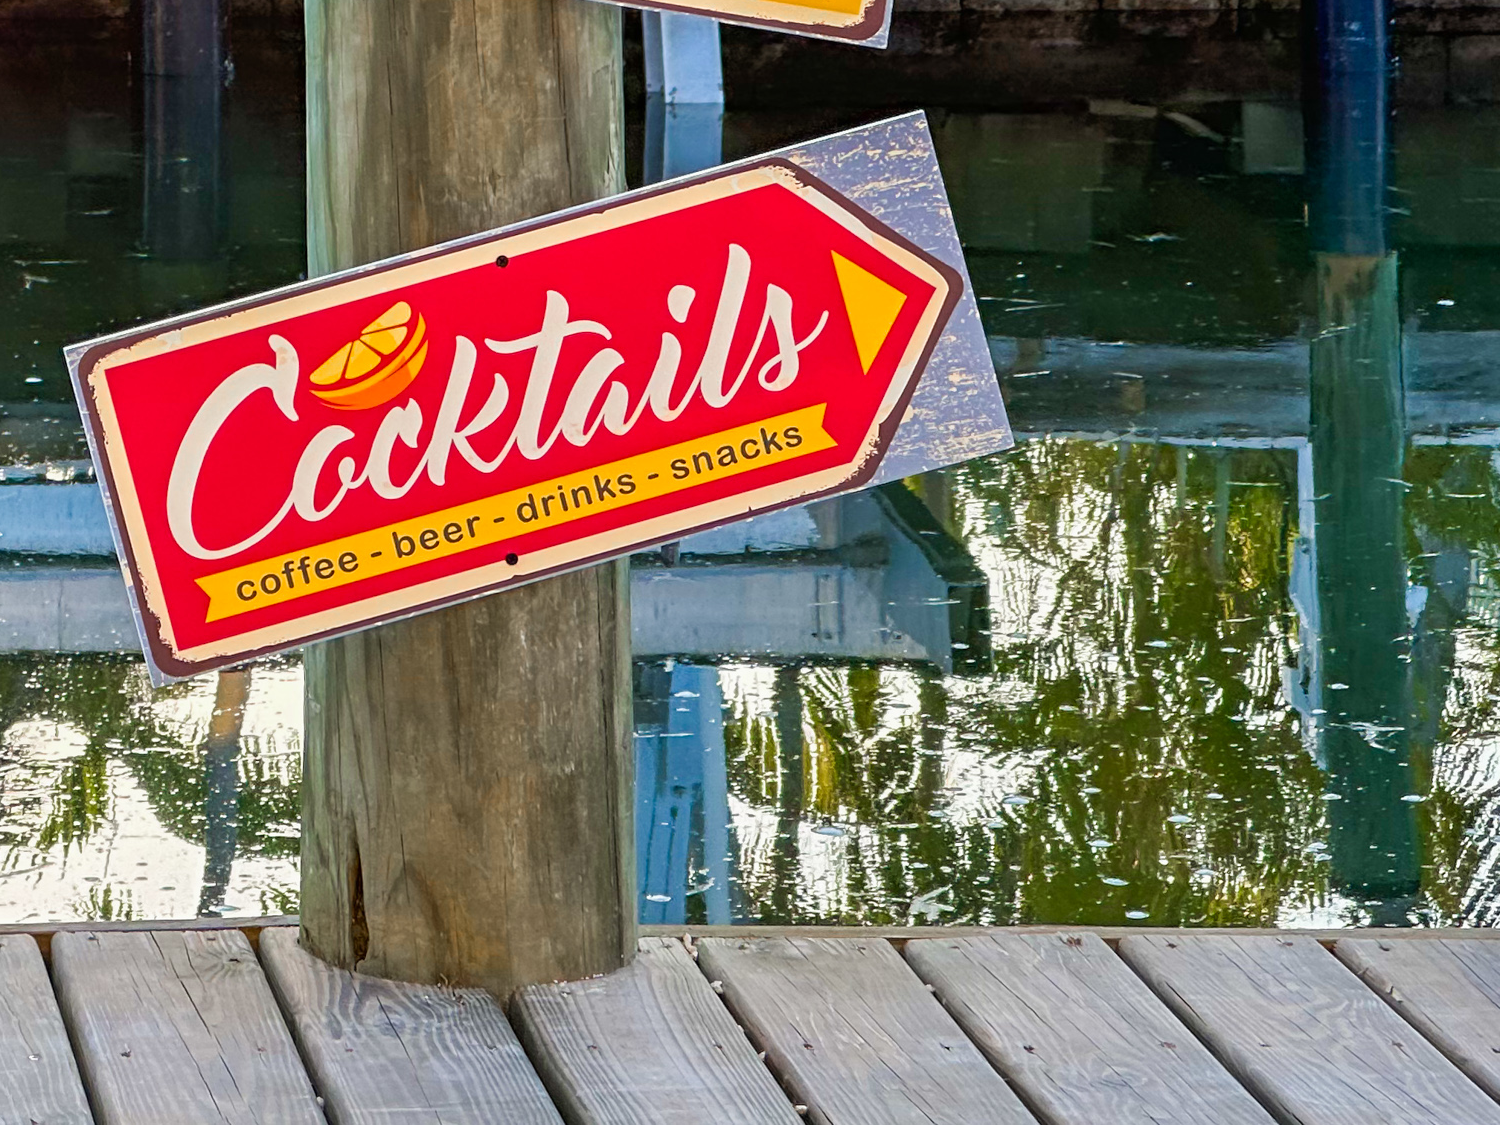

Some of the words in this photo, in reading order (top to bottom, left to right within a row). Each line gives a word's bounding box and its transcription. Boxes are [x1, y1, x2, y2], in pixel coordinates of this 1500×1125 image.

[166, 243, 828, 560] Cocktails
[236, 551, 359, 601] coffee
[392, 516, 481, 559] beer
[517, 474, 636, 524] drinks
[670, 428, 803, 480] snacks
